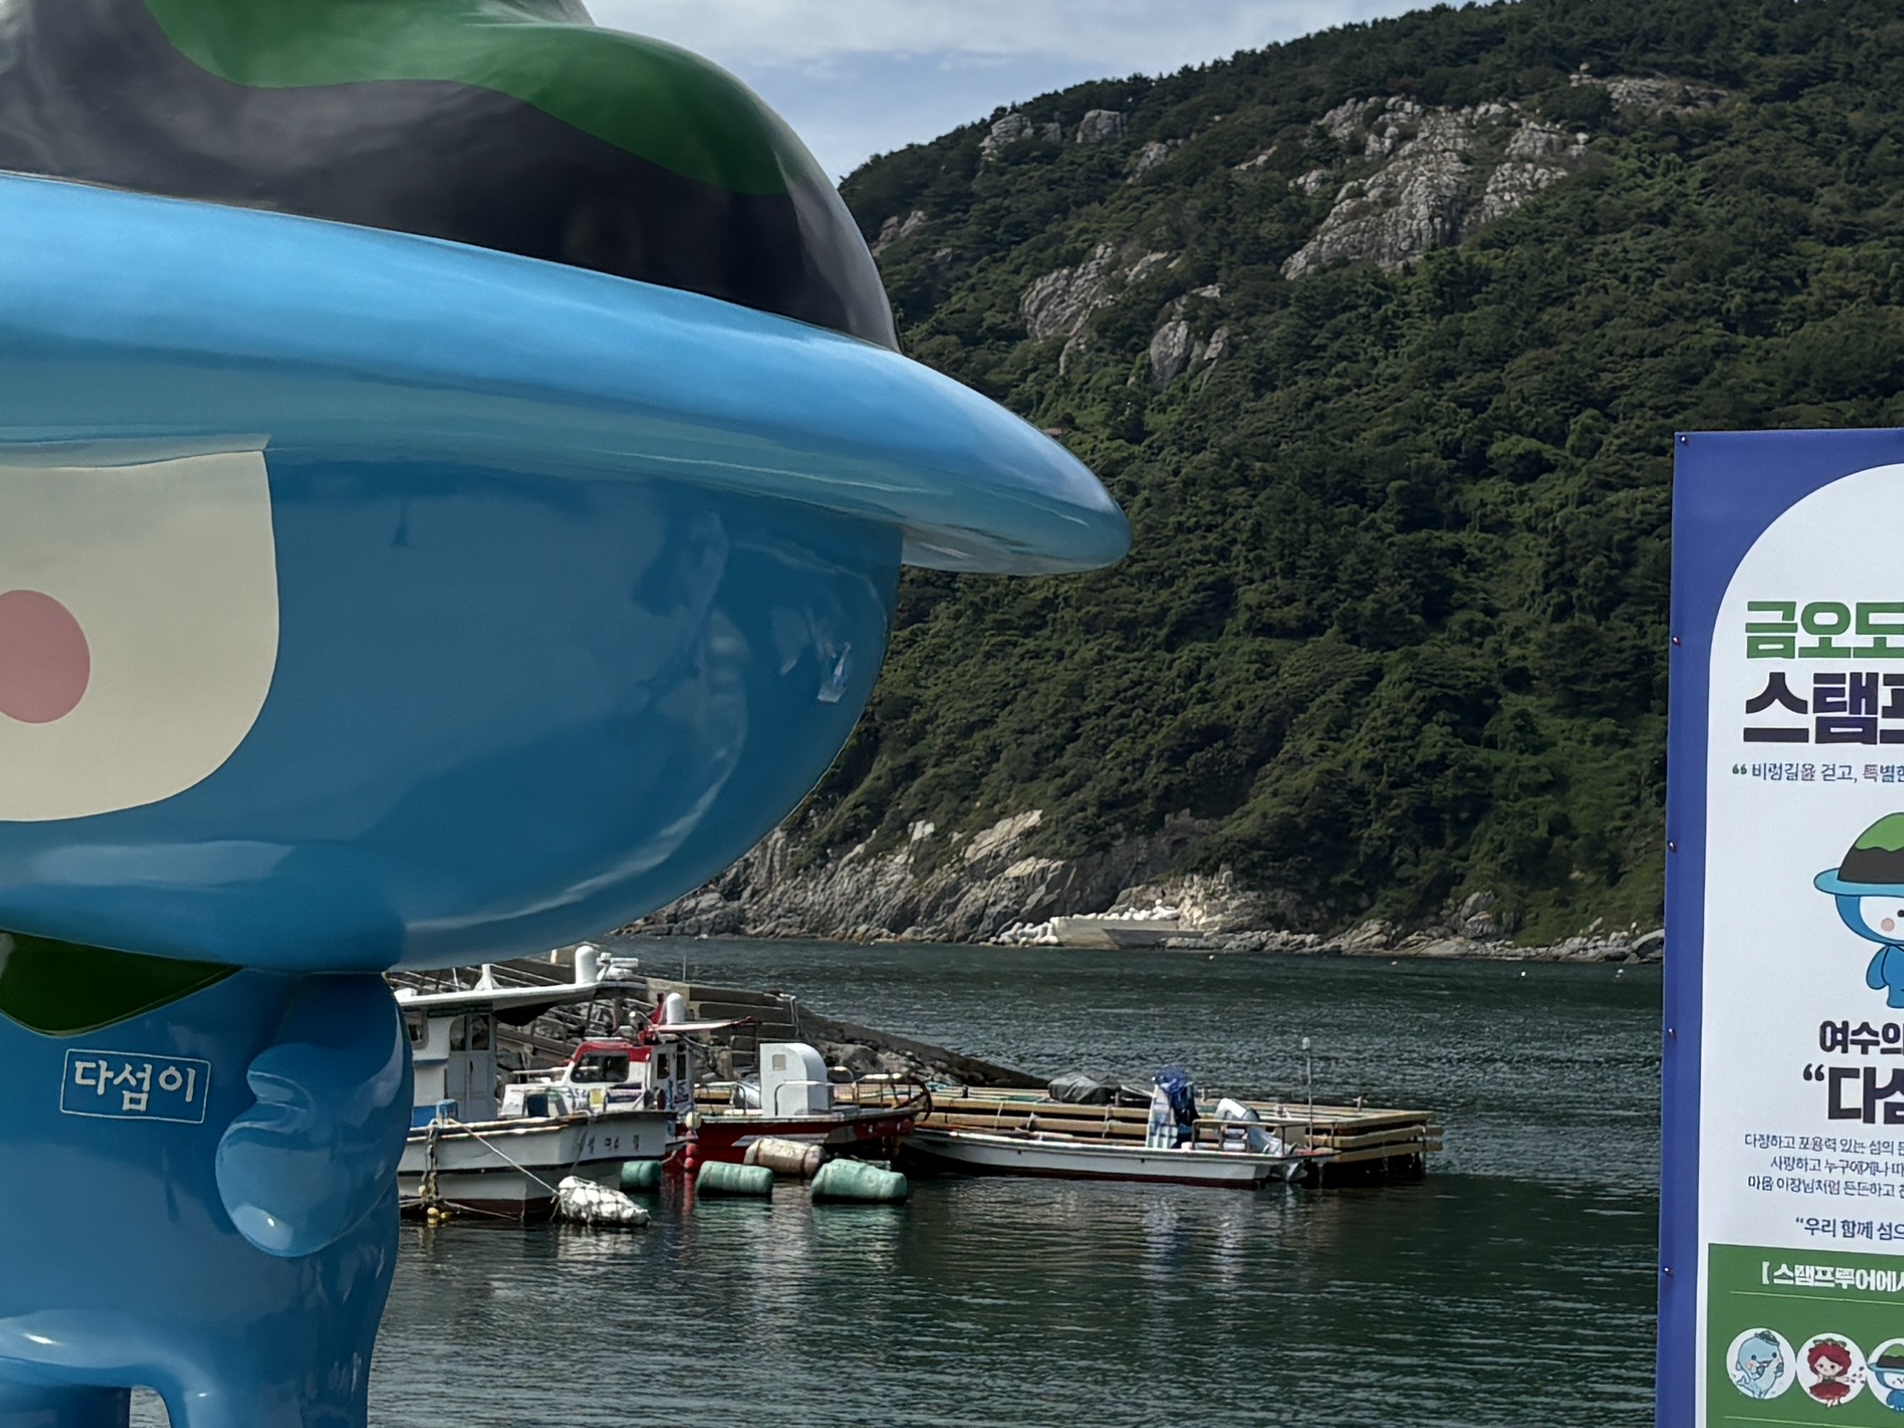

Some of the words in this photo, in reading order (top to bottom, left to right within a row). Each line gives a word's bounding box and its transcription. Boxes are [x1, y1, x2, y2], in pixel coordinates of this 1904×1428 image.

[1821, 763, 1857, 783] 걷고,
[75, 1060, 196, 1112] 다섬이
[1841, 1219, 1873, 1240] 함께
